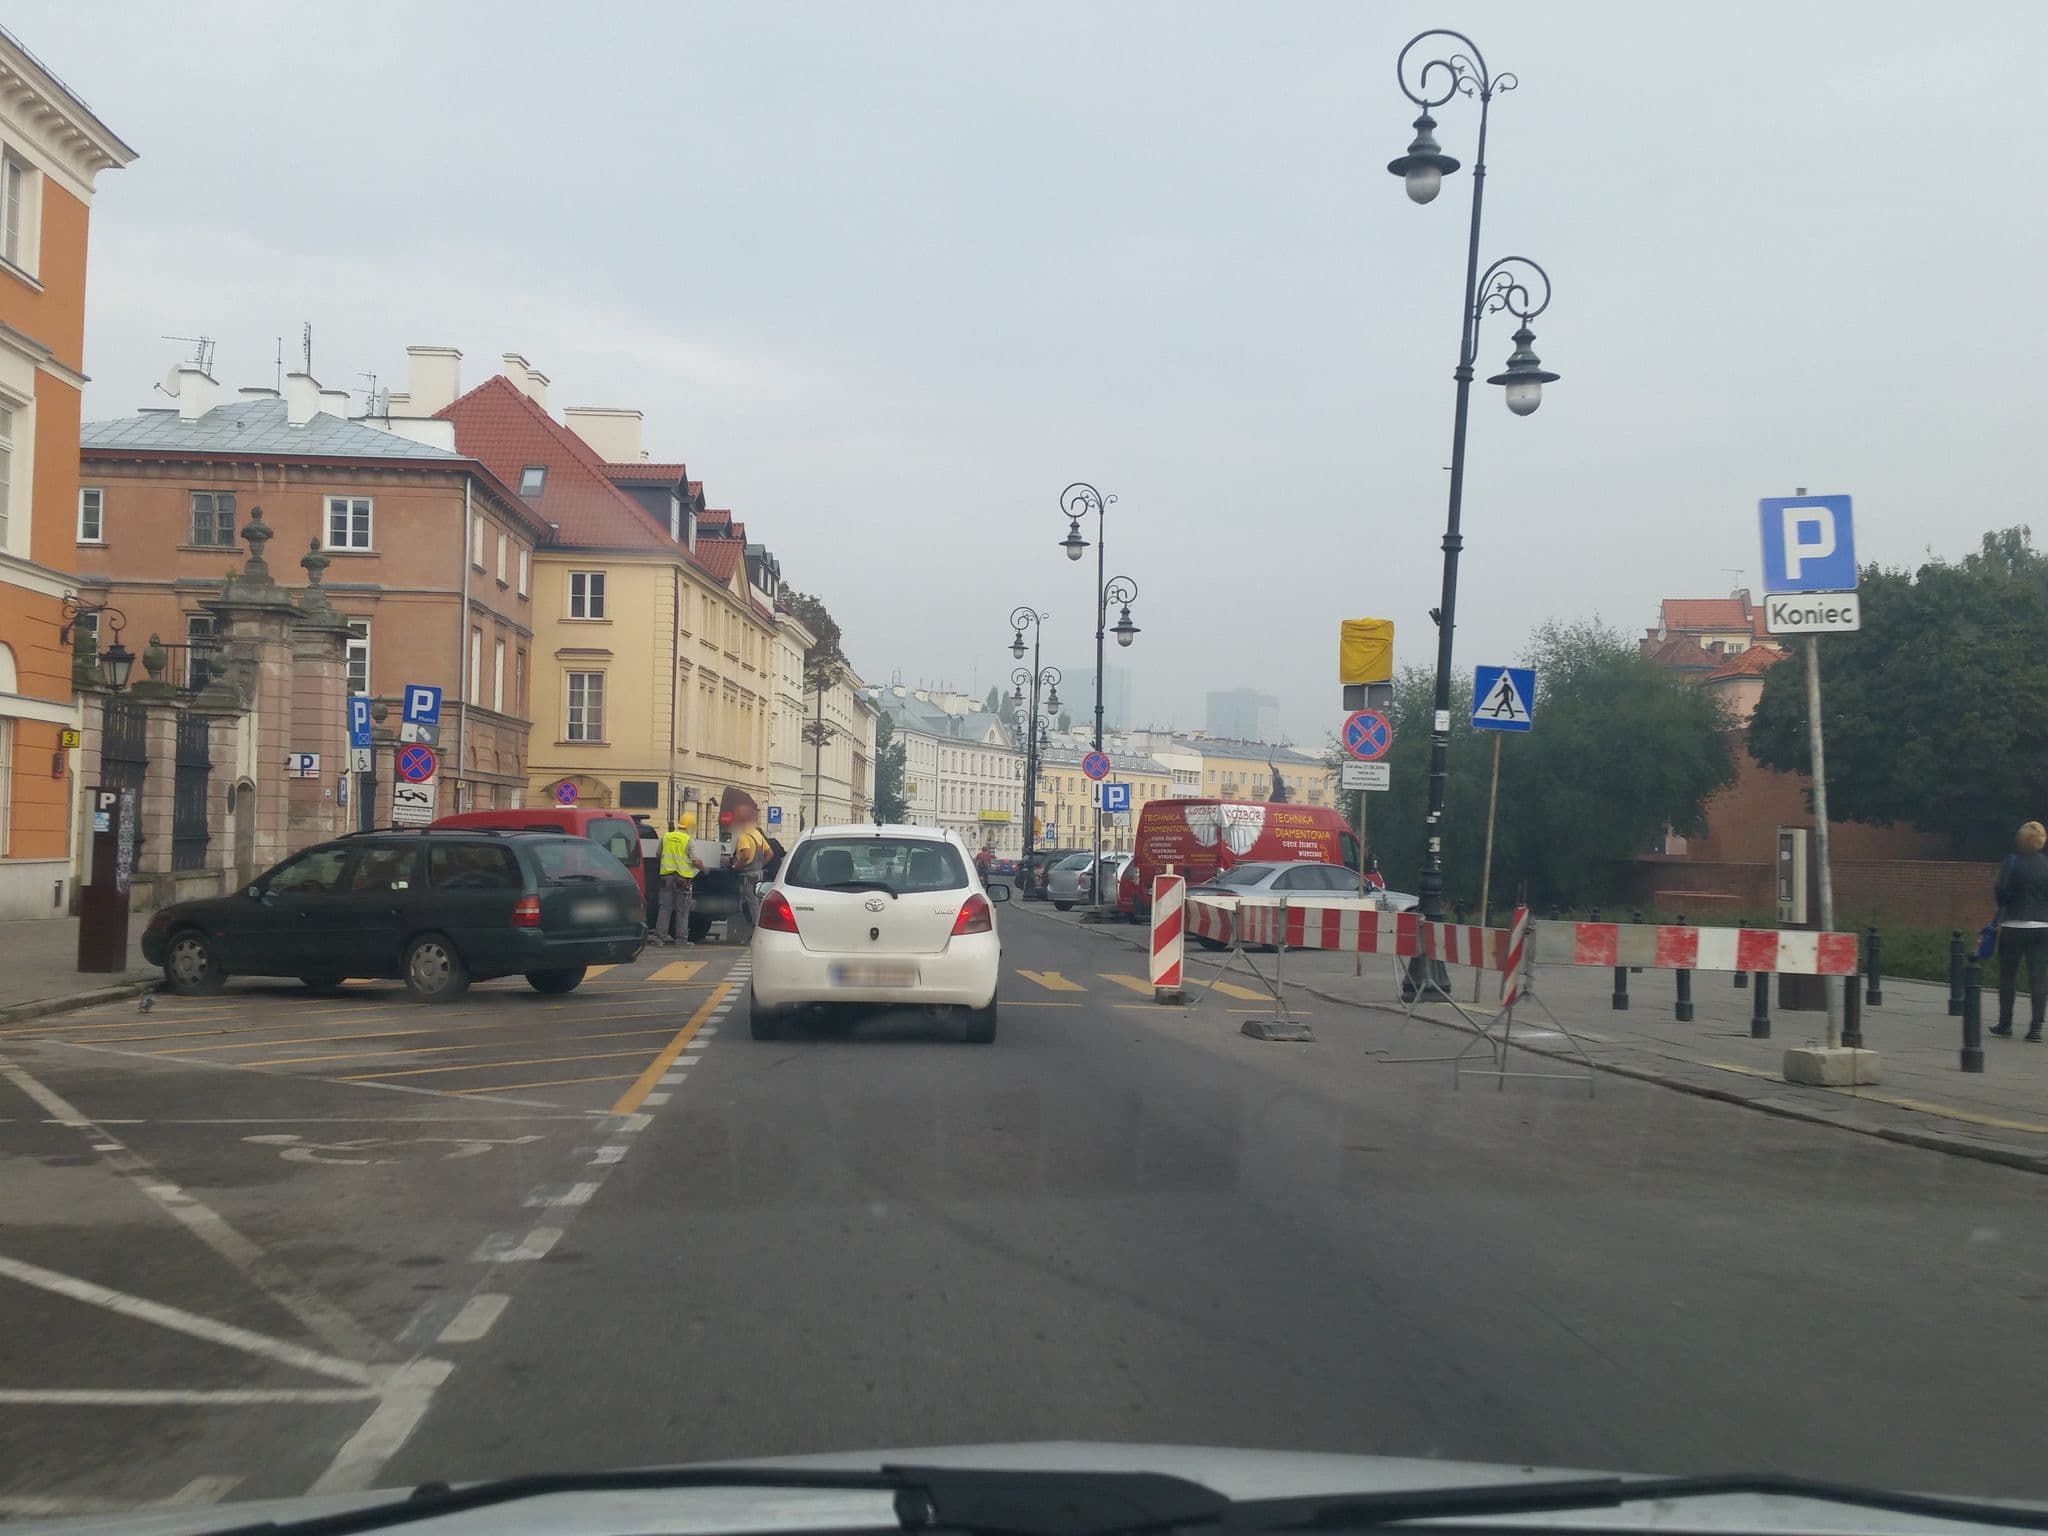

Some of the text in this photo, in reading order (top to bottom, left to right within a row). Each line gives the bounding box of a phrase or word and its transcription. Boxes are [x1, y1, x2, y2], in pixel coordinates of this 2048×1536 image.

[1782, 506, 1836, 580] P
[1772, 601, 1853, 625] Koniec
[410, 689, 434, 719] P
[354, 701, 367, 733] P
[66, 732, 75, 743] 3
[301, 755, 314, 776] P
[101, 792, 117, 809] P
[1108, 786, 1125, 809] P
[770, 808, 779, 819] P
[1144, 814, 1181, 822] TECHNIKA
[1226, 808, 1261, 821] KOZBOR
[1273, 812, 1314, 825] TECHNIKA
[1274, 828, 1331, 841] DIAMENTOWA
